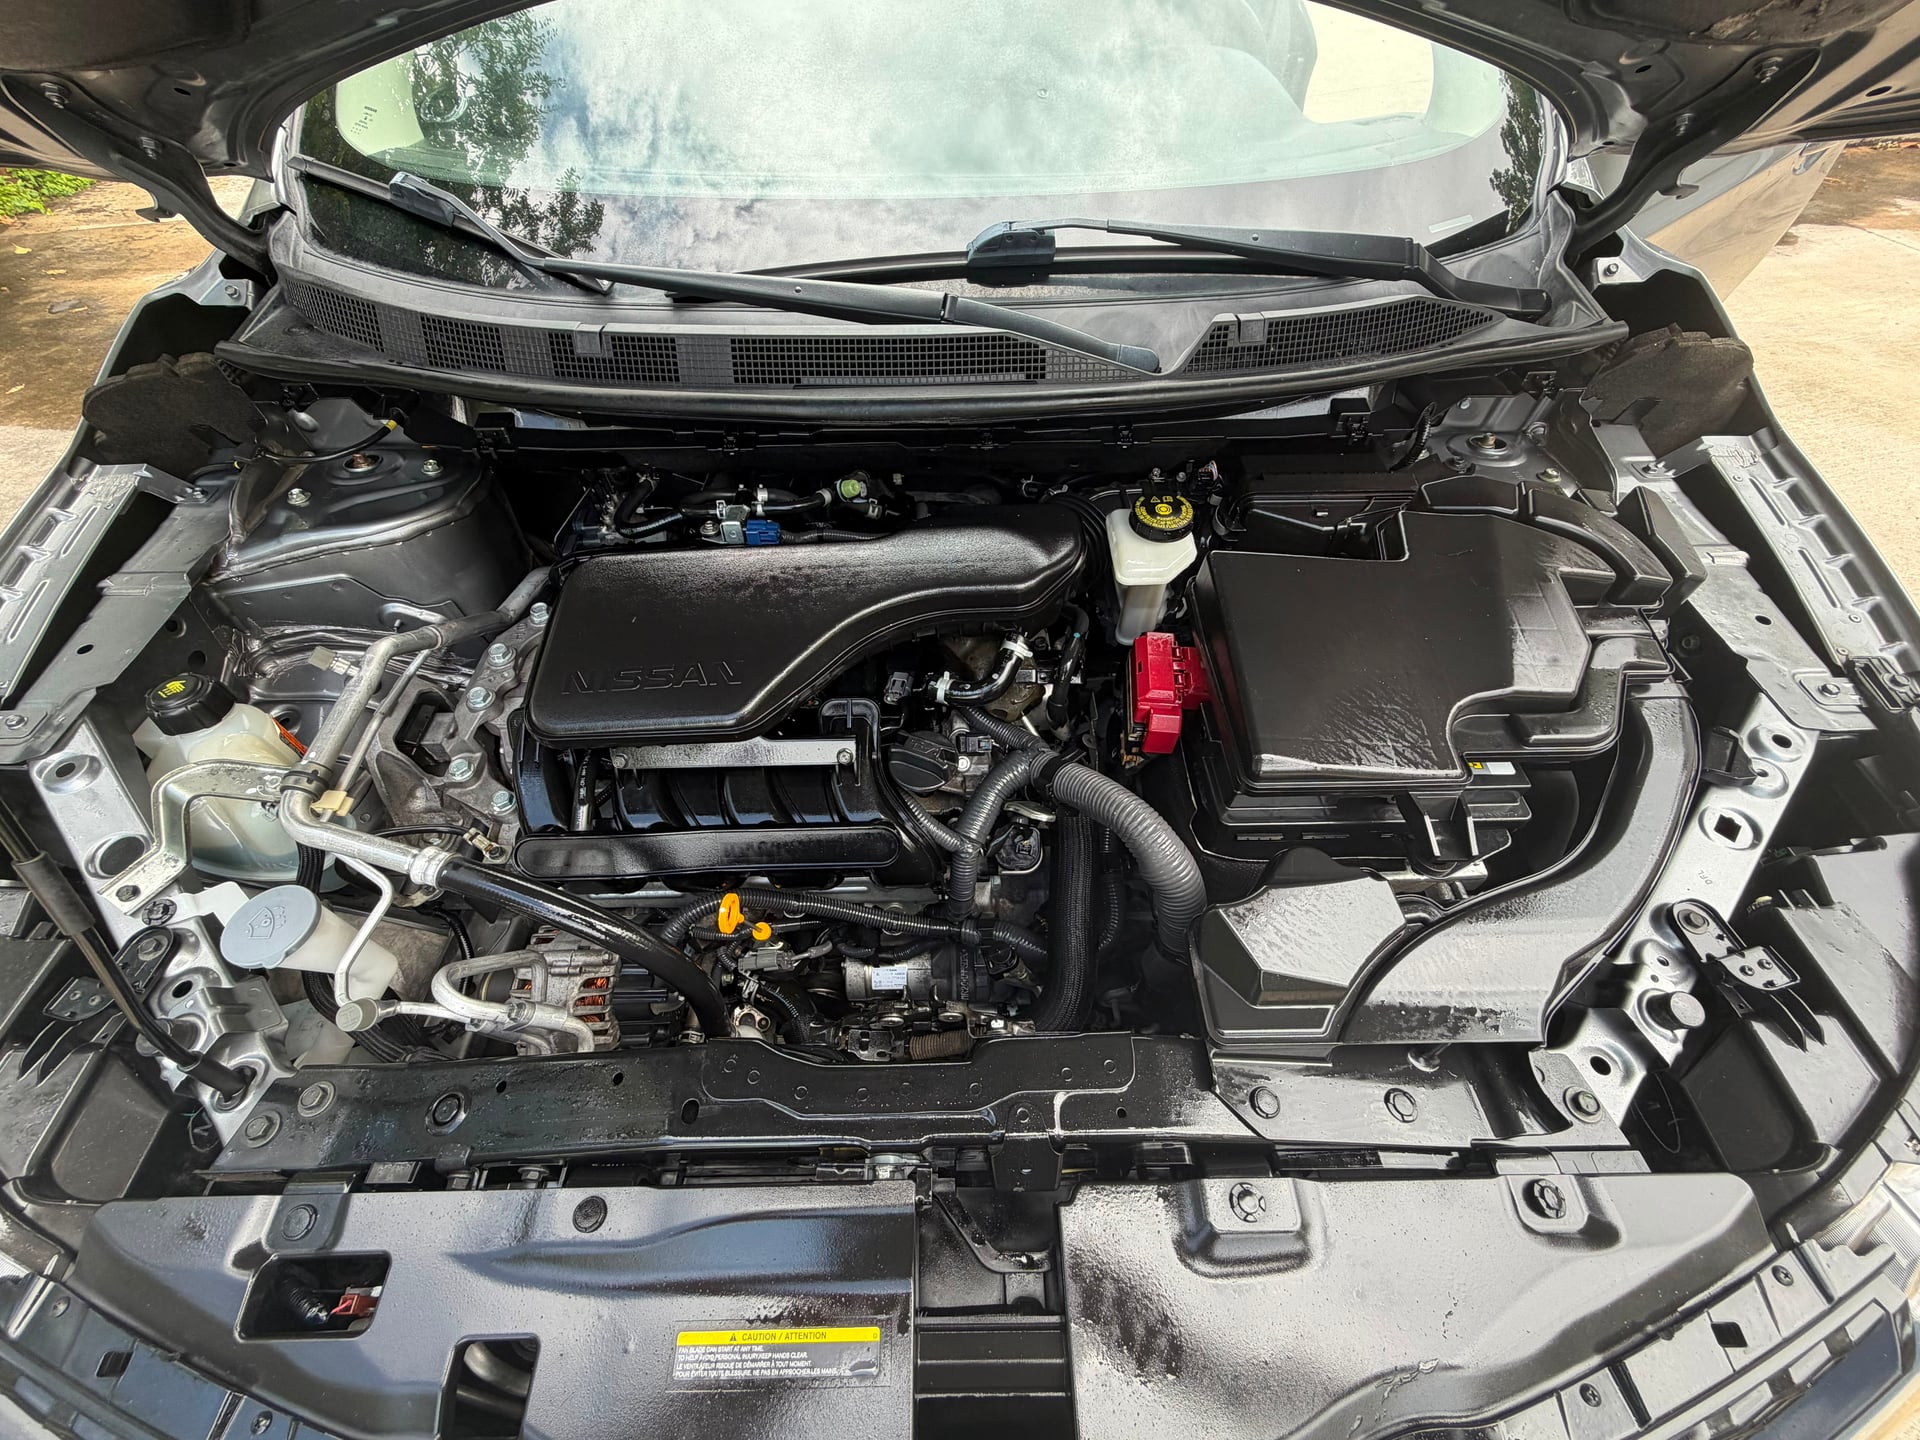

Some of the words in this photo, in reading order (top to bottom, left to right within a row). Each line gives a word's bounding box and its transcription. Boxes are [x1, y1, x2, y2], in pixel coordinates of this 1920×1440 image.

[561, 659, 745, 695] NISSAN
[742, 1332, 776, 1341] CAUTION
[778, 1332, 783, 1340] /
[785, 1331, 827, 1340] ATTENTION
[716, 1362, 734, 1370] RISQUE
